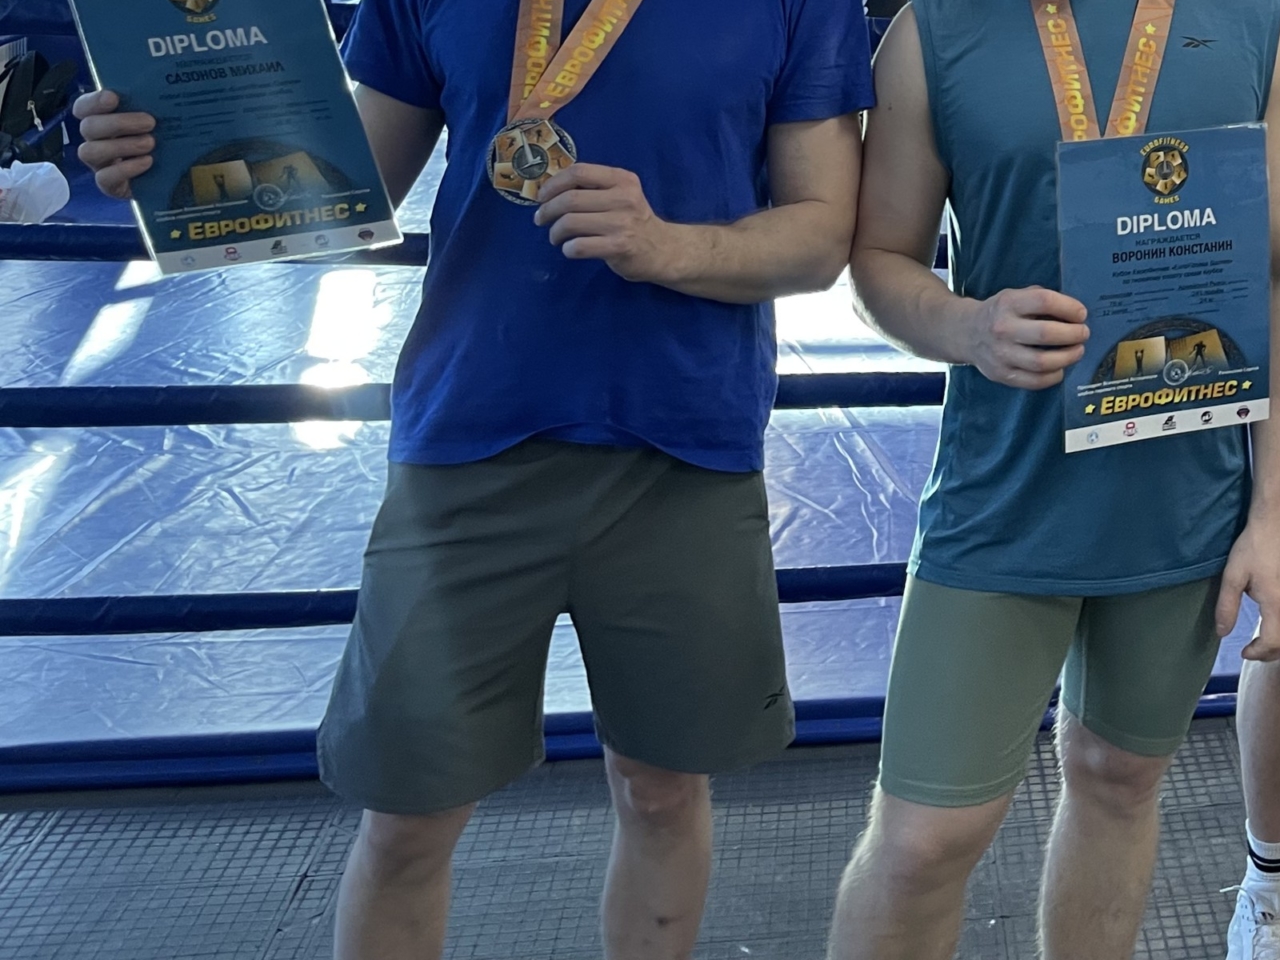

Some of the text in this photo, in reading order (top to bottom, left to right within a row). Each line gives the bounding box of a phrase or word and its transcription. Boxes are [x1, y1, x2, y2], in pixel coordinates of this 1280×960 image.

[148, 26, 268, 57] DIPLOMA
[165, 67, 228, 85] САЗОНОВ
[187, 202, 350, 240] ЕВРОФИТНЕС
[1116, 207, 1217, 235] DIPLOMA
[1111, 239, 1233, 264] ВОРОНИН КОНСТАНИН
[1100, 380, 1238, 415] ЕВРОФИТНЕС
